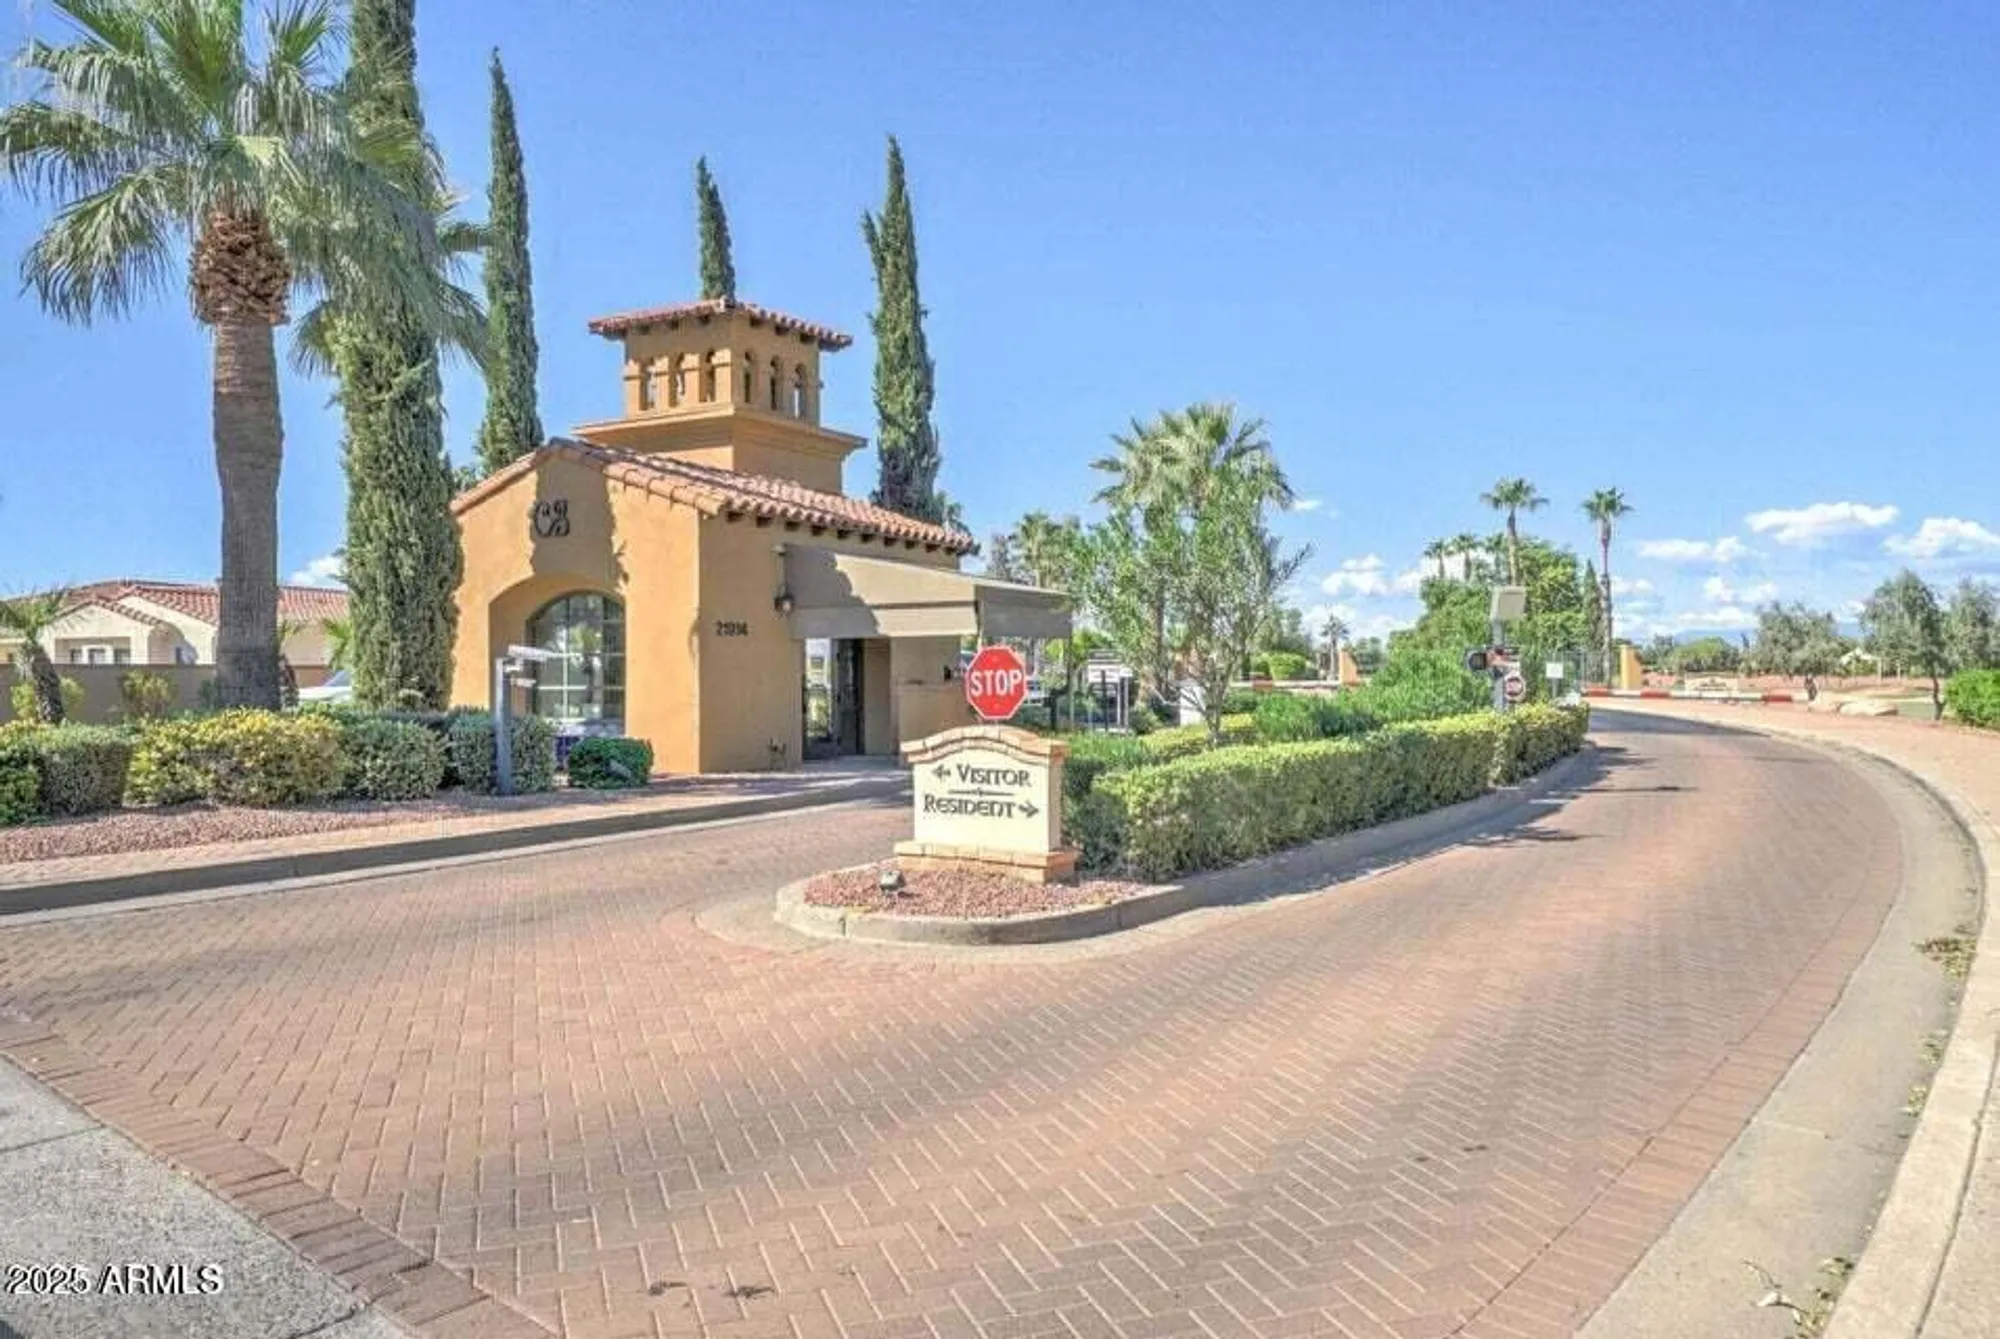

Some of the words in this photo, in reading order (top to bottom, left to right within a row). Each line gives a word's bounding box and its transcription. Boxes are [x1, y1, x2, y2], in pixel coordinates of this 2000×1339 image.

[970, 669, 1022, 697] STOP
[956, 764, 1032, 787] VISITOR
[923, 793, 1016, 818] RESIDENT
